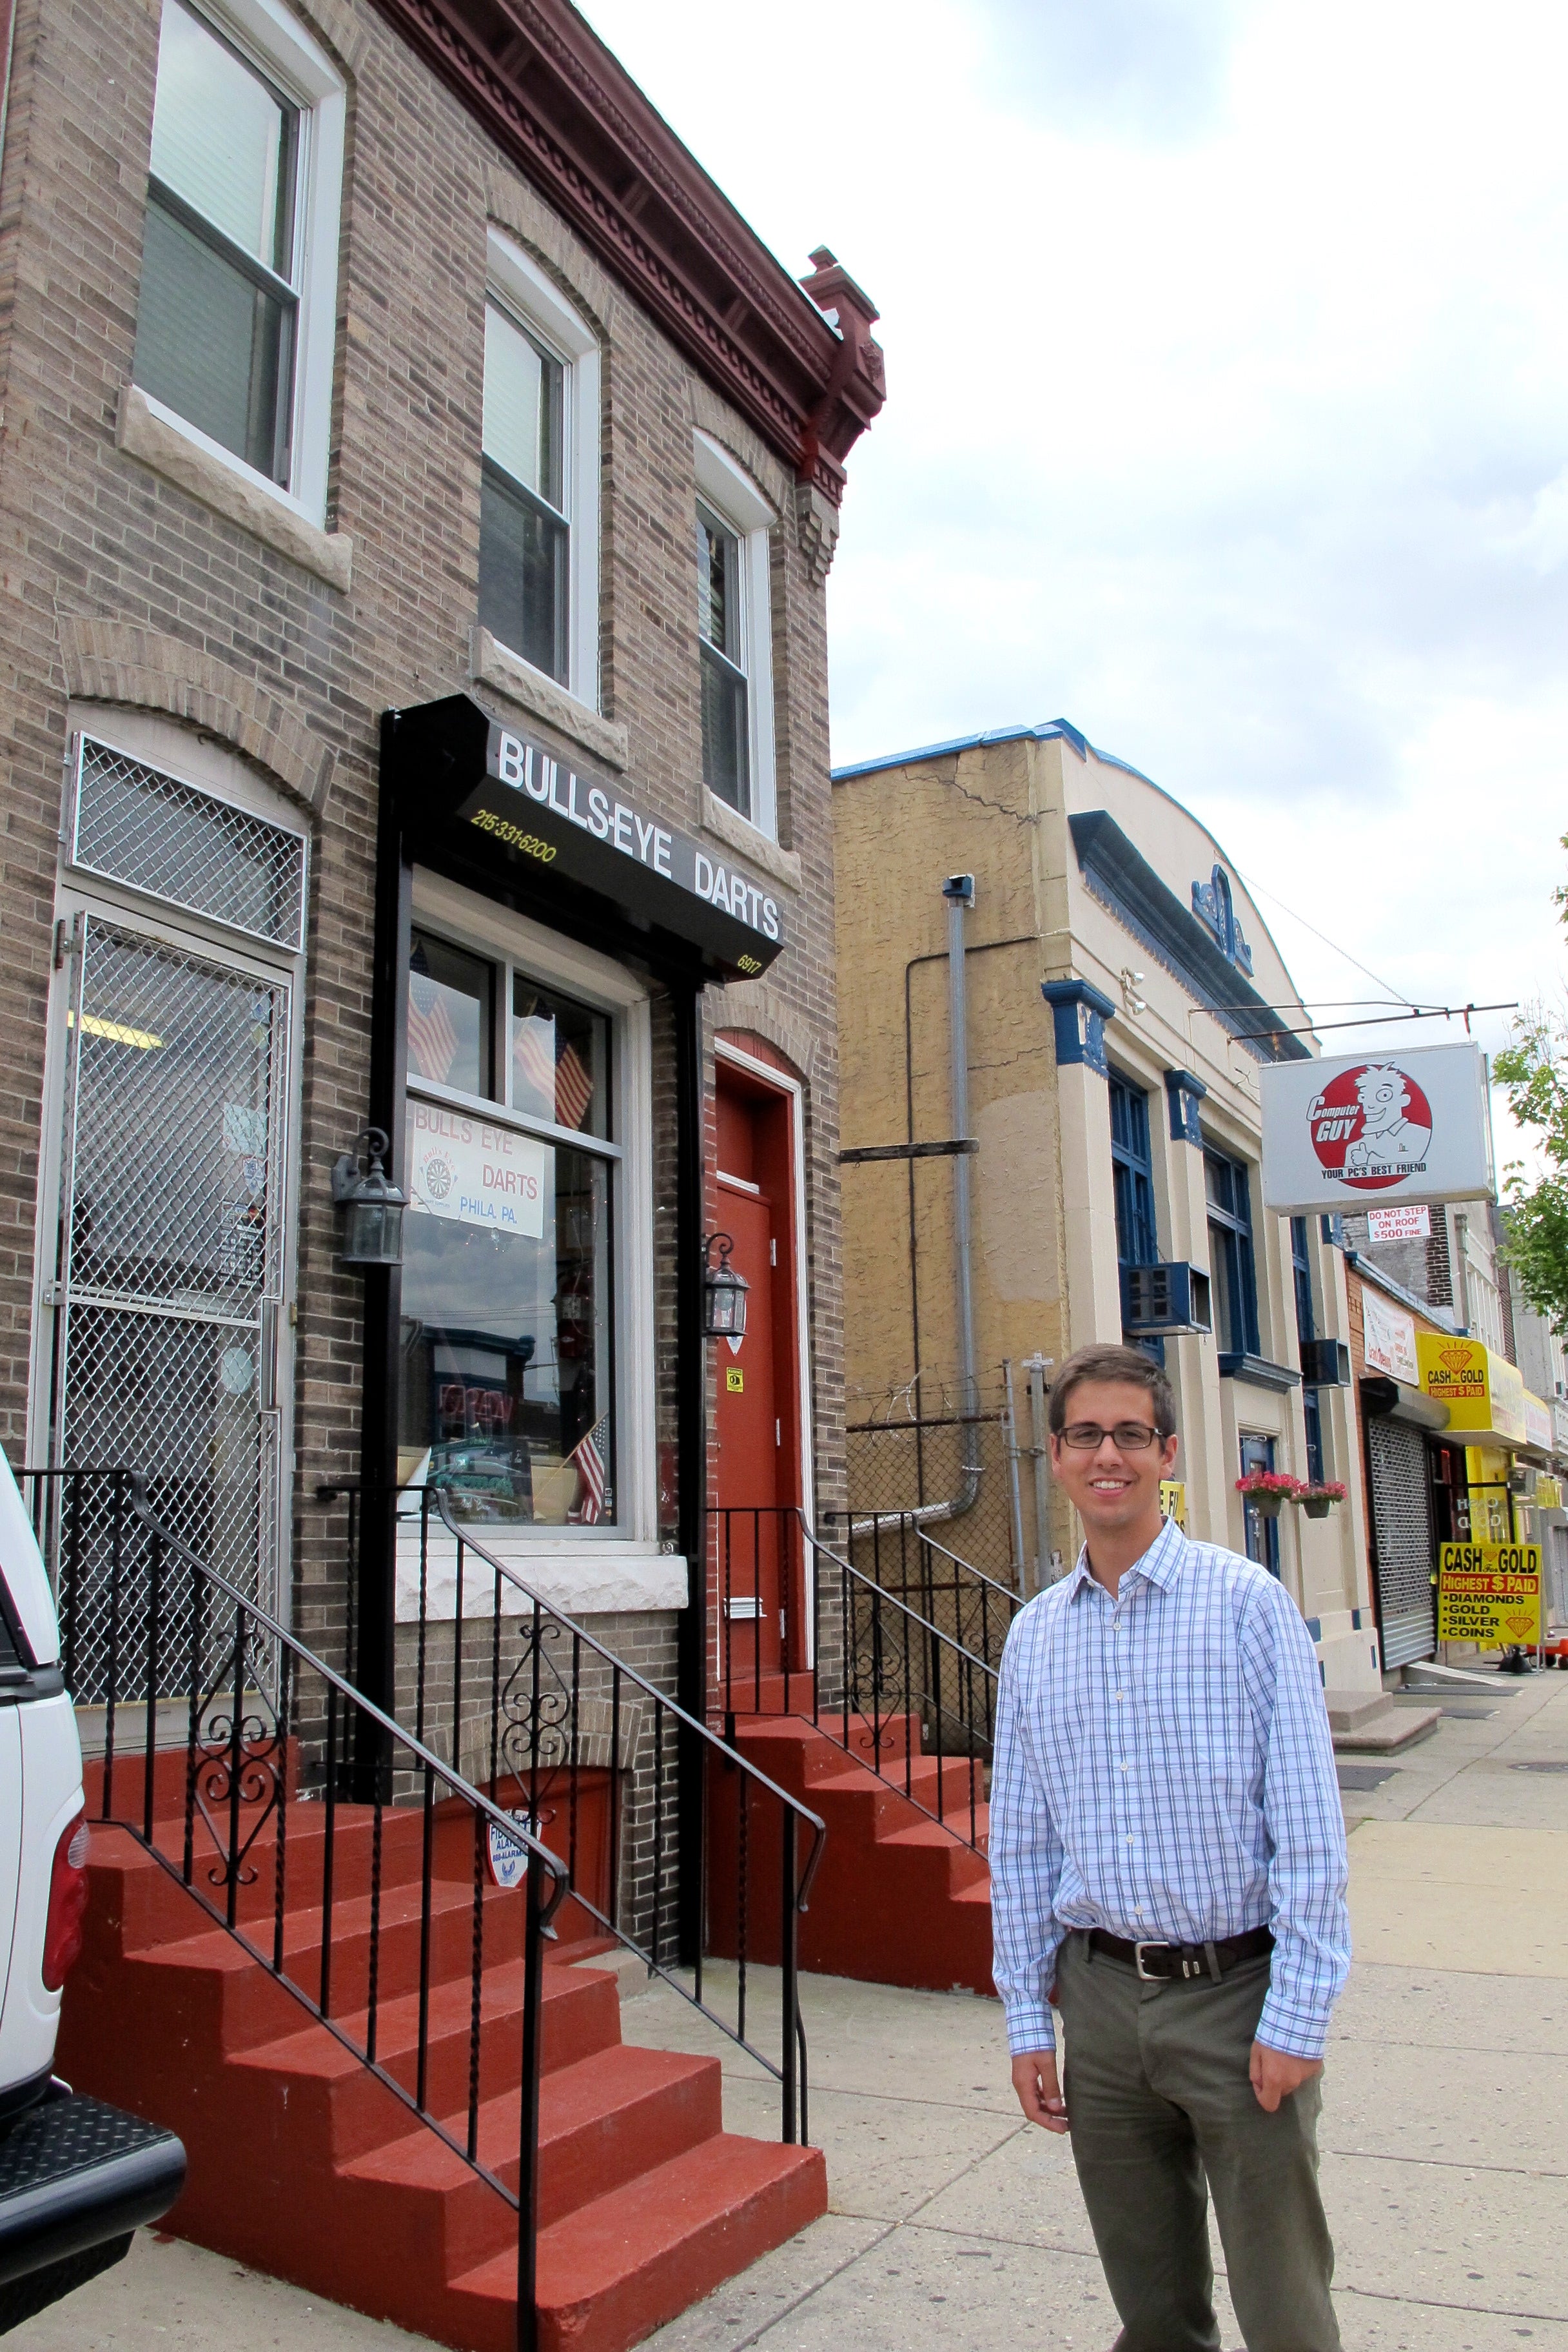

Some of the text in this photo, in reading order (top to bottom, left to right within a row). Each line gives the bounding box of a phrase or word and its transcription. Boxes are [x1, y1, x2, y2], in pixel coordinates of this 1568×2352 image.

[694, 851, 778, 940] DARTS
[738, 954, 762, 974] 6917
[1306, 1095, 1360, 1121] Computer
[415, 1105, 513, 1155] BULLS EYE
[1316, 1118, 1357, 1142] GUY
[1322, 1162, 1427, 1180] YOUR PC'S BEST FRIEND
[483, 1164, 538, 1200] DARTS
[1384, 1209, 1402, 1219] NOT
[1404, 1206, 1426, 1216] STEP
[1378, 1217, 1420, 1229] ON ROOF
[1374, 1228, 1403, 1239] $500
[1427, 1369, 1451, 1384] CASH
[1460, 1369, 1484, 1383] GOLD
[1431, 1386, 1484, 1397] HIGHEST $ PAID
[1444, 1547, 1482, 1573] CASH
[1498, 1549, 1536, 1574] GOLD
[1491, 1574, 1505, 1592] $
[1507, 1576, 1536, 1592] PAID
[1449, 1593, 1524, 1605] DIAMONDS
[1449, 1604, 1490, 1614] GOLD
[1448, 1616, 1500, 1627] SILVER
[1448, 1627, 1494, 1638] COINS
